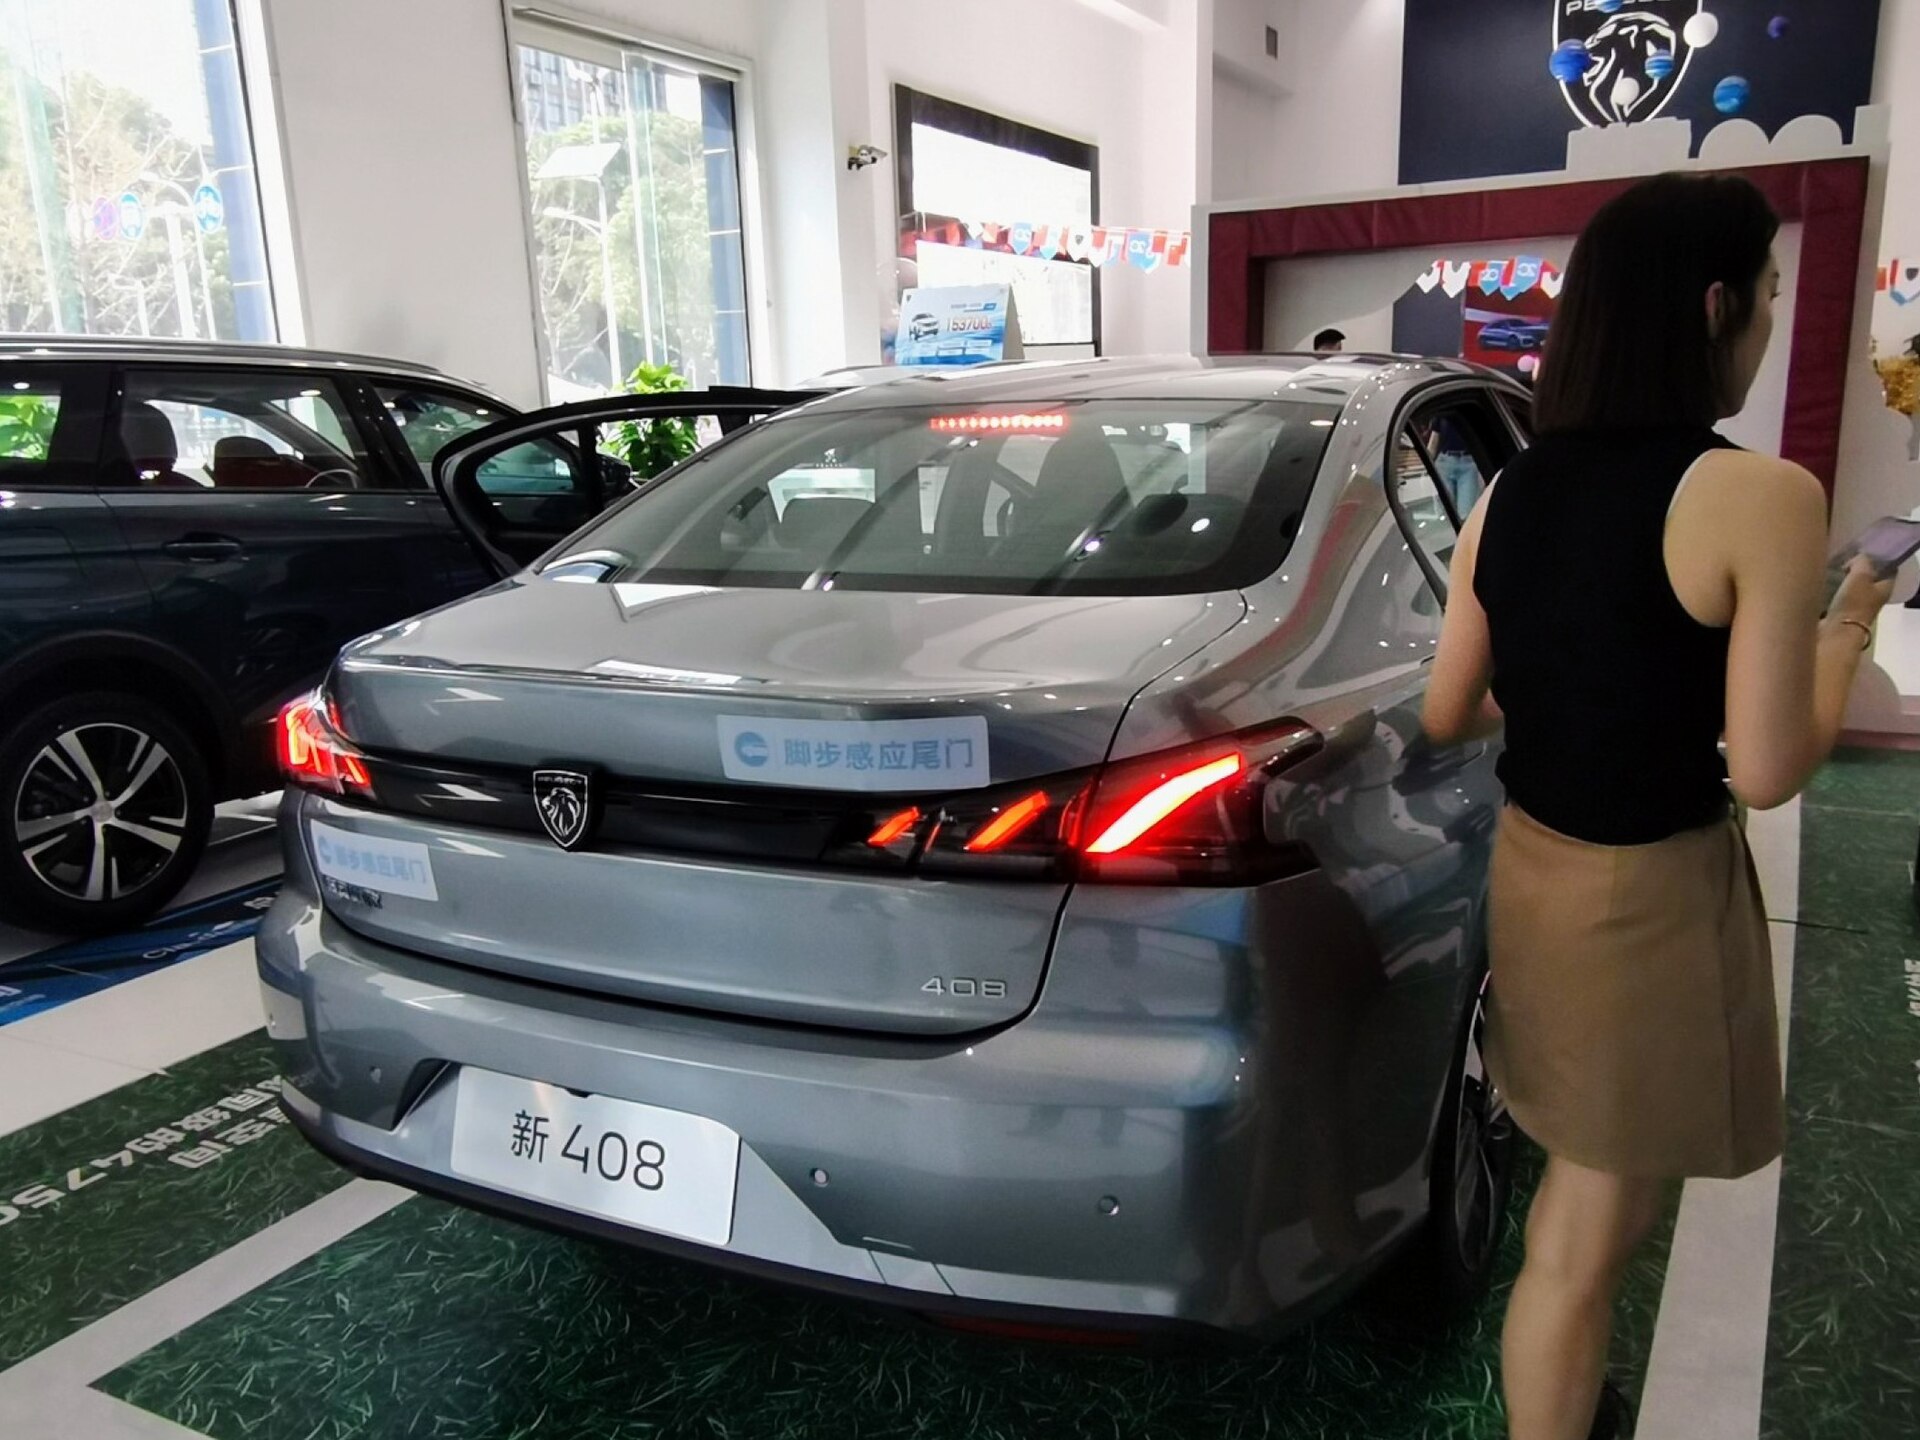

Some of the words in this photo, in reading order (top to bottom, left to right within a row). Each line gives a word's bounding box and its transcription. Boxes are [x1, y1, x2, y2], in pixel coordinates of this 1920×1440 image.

[784, 738, 974, 770] 脚步感应尾门
[920, 976, 1006, 998] 408
[510, 1110, 549, 1163] 新
[561, 1124, 665, 1191] 408
